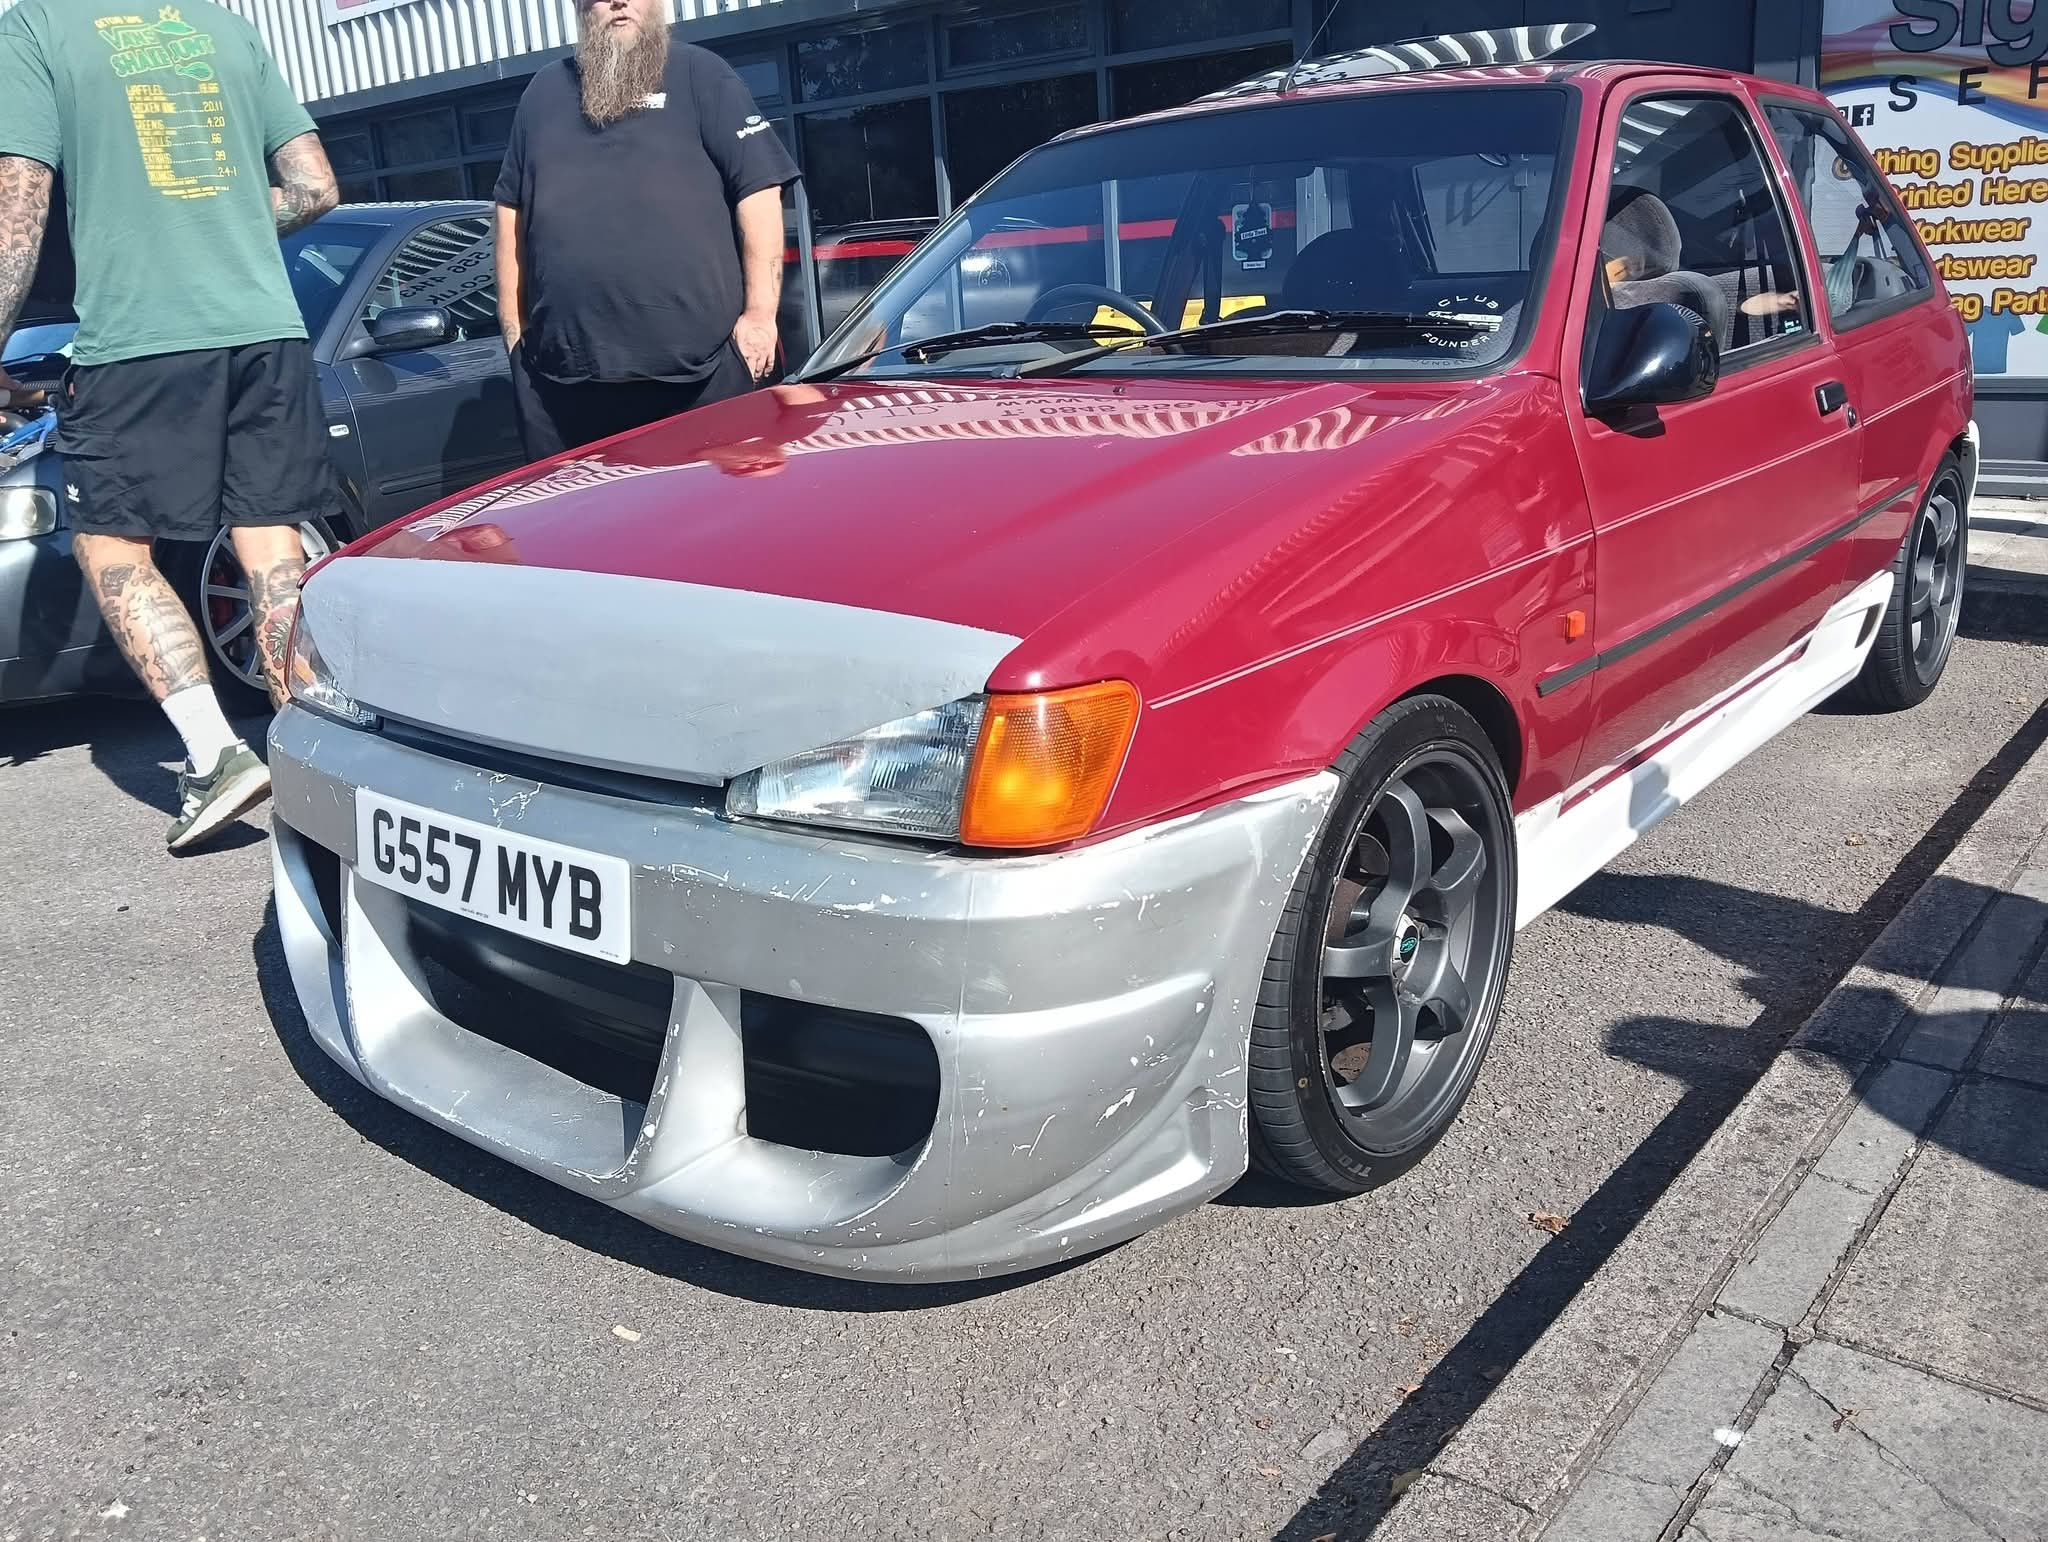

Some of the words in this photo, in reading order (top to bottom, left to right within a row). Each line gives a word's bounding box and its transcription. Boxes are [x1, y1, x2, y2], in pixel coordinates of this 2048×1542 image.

[99, 24, 161, 51] VANS
[110, 46, 174, 77] SHAKE
[1894, 181, 1973, 210] rinted
[1981, 177, 2048, 205] Here
[1438, 294, 1499, 309] CLUB
[1421, 332, 1490, 348] FOUNDER
[373, 808, 481, 903] G557
[498, 845, 602, 941] MYB
